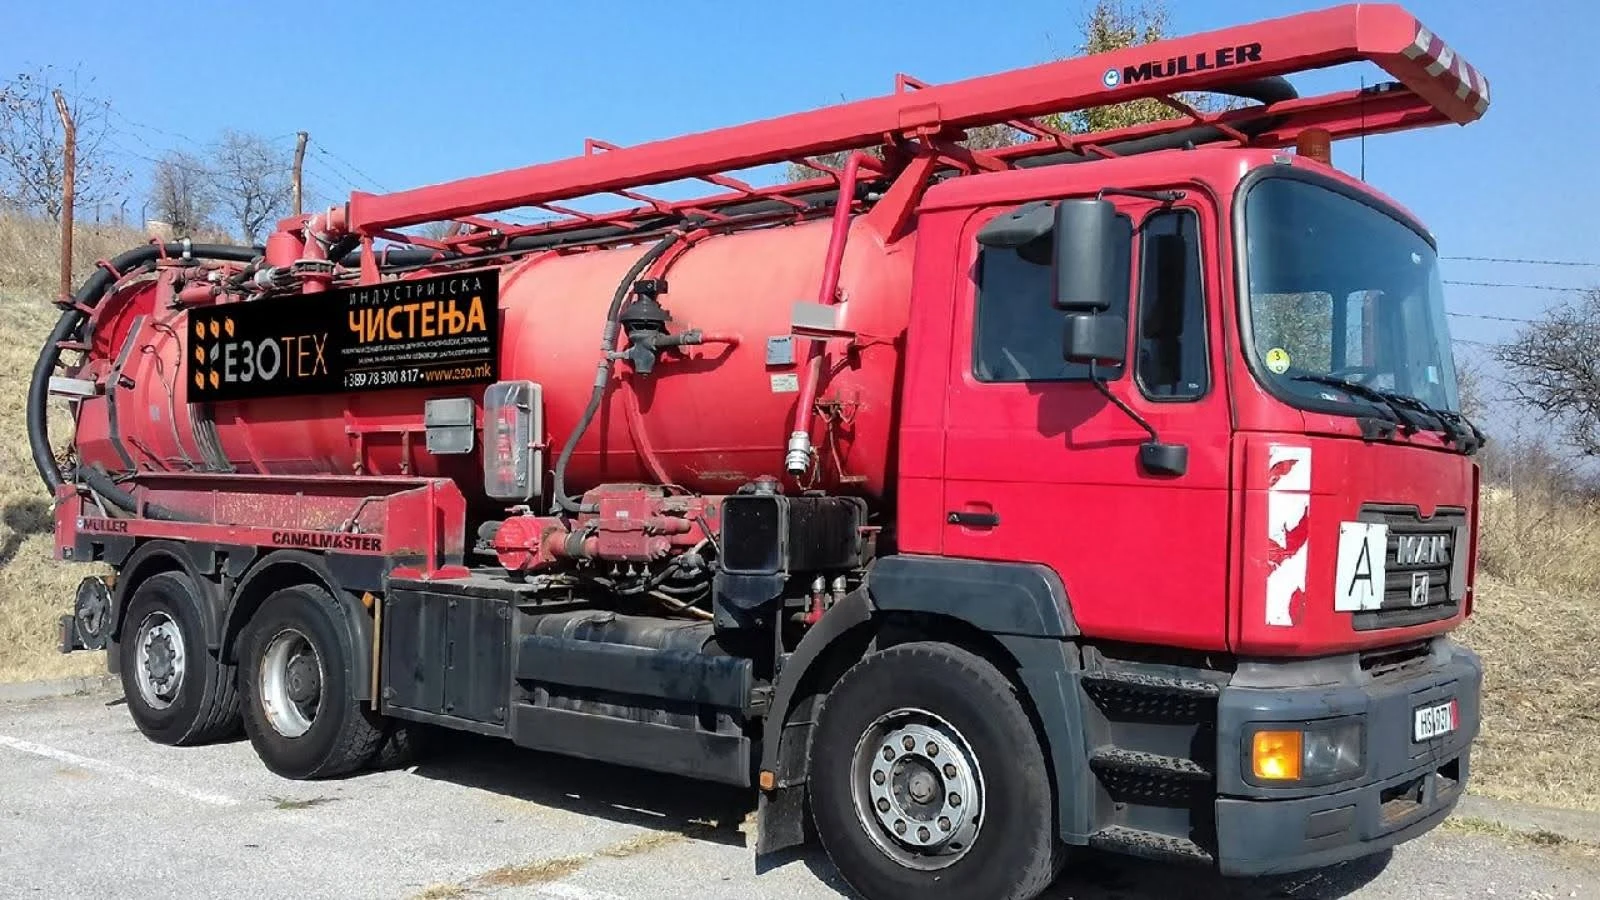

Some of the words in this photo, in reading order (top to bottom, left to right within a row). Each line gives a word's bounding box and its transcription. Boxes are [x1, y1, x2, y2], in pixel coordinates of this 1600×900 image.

[1123, 42, 1262, 84] MÜLLER
[348, 296, 487, 344] ЧИСТЕЊА
[380, 370, 399, 385] 300
[400, 368, 420, 383] 817
[272, 532, 382, 552] CANALMASTER
[1397, 535, 1446, 564] MAN
[1348, 536, 1375, 597] A
